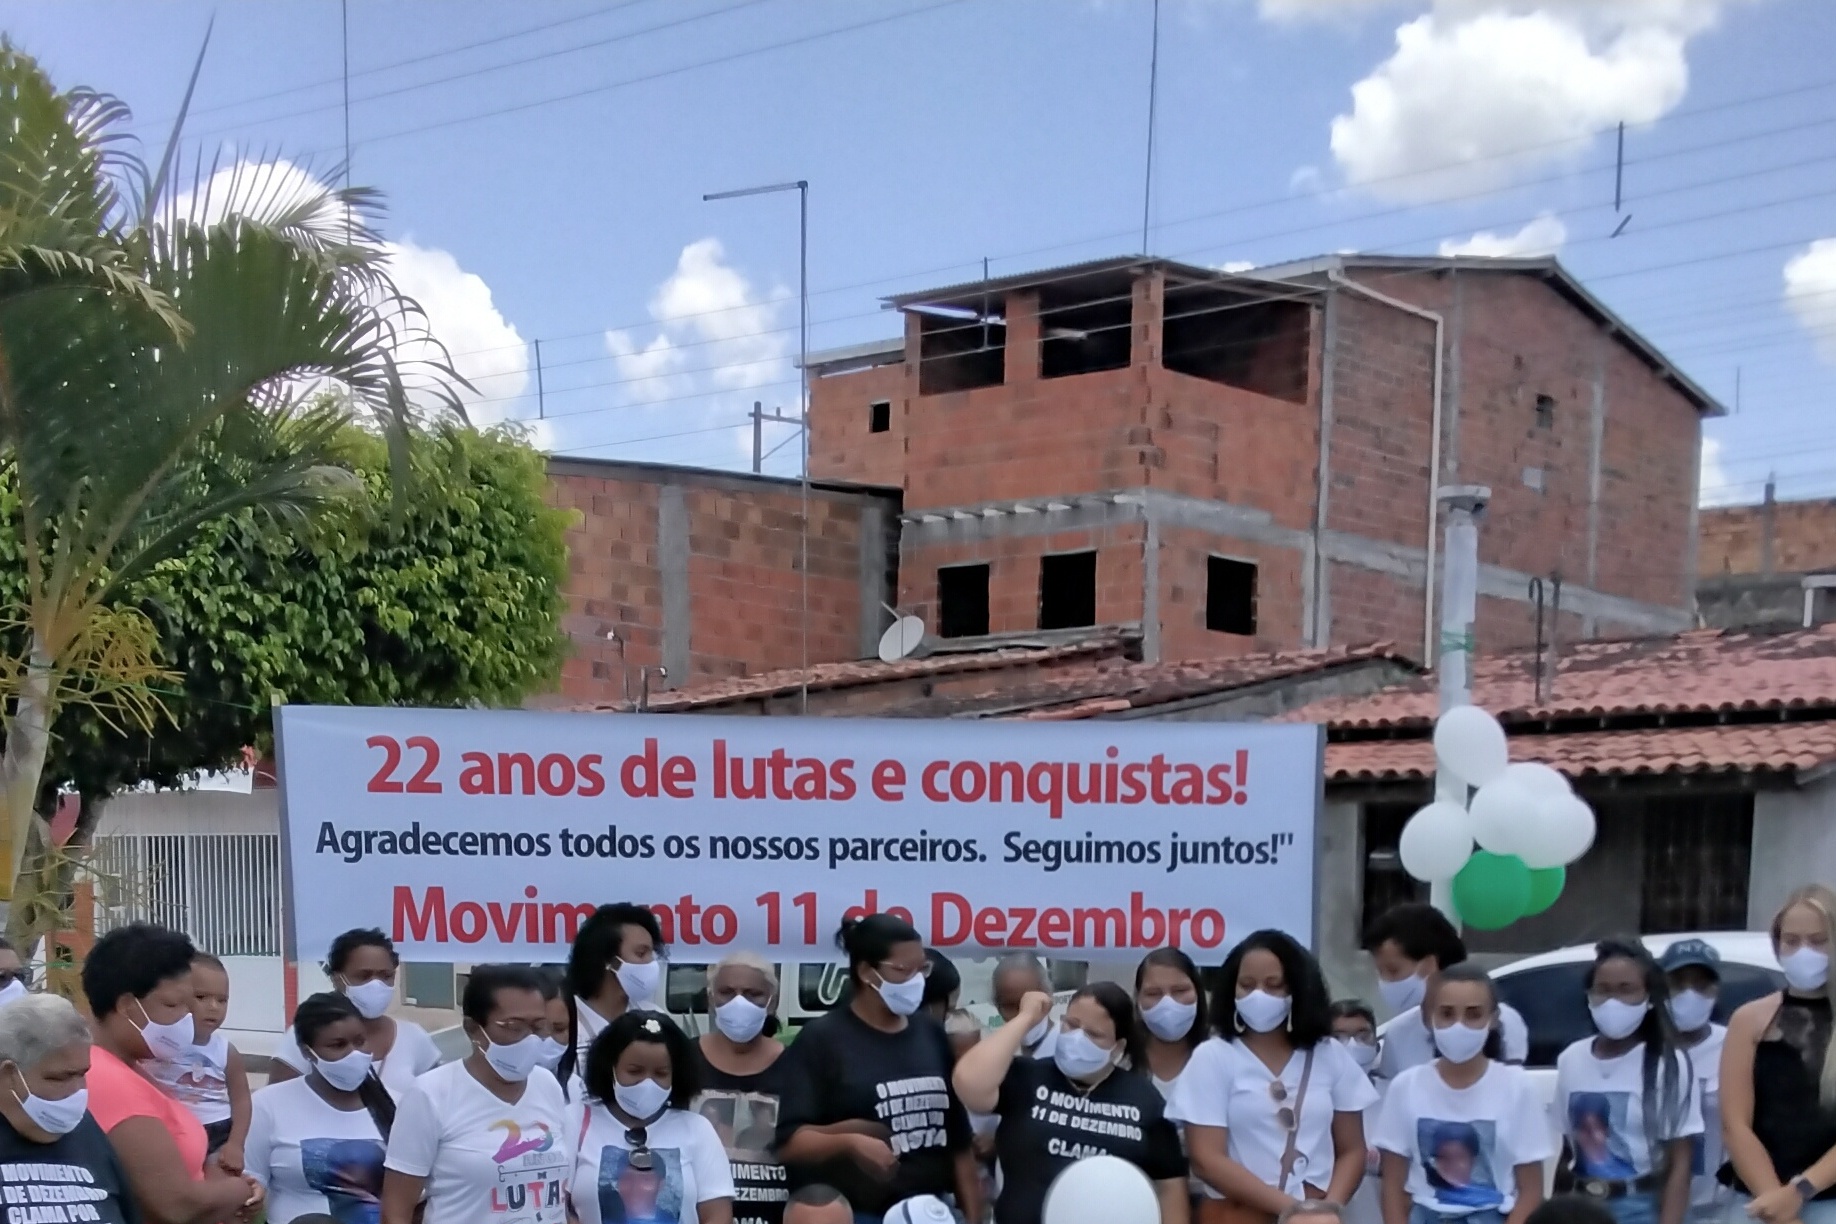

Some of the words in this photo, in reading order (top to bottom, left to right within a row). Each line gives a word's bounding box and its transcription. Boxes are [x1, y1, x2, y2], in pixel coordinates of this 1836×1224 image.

[366, 735, 443, 794] 22
[459, 750, 605, 797] anos
[620, 738, 697, 799] de
[713, 739, 857, 801] lutas
[871, 758, 907, 802] e
[921, 746, 1248, 819] conquistas!
[315, 821, 552, 864] Agradecemos
[558, 824, 656, 859] todos
[663, 835, 701, 860] os
[709, 834, 820, 861] nossos
[828, 830, 988, 870] parceiros.
[1003, 831, 1162, 873] Seguimos
[392, 884, 738, 949] Movimnto
[756, 891, 817, 945] 11
[931, 891, 1226, 950] Dezembro
[1031, 1104, 1047, 1121] 11
[1048, 1110, 1069, 1126] DE
[1070, 1115, 1142, 1142] DEZEMBRO
[1036, 1084, 1049, 1101] O
[1049, 1091, 1140, 1122] MOVIMENTO
